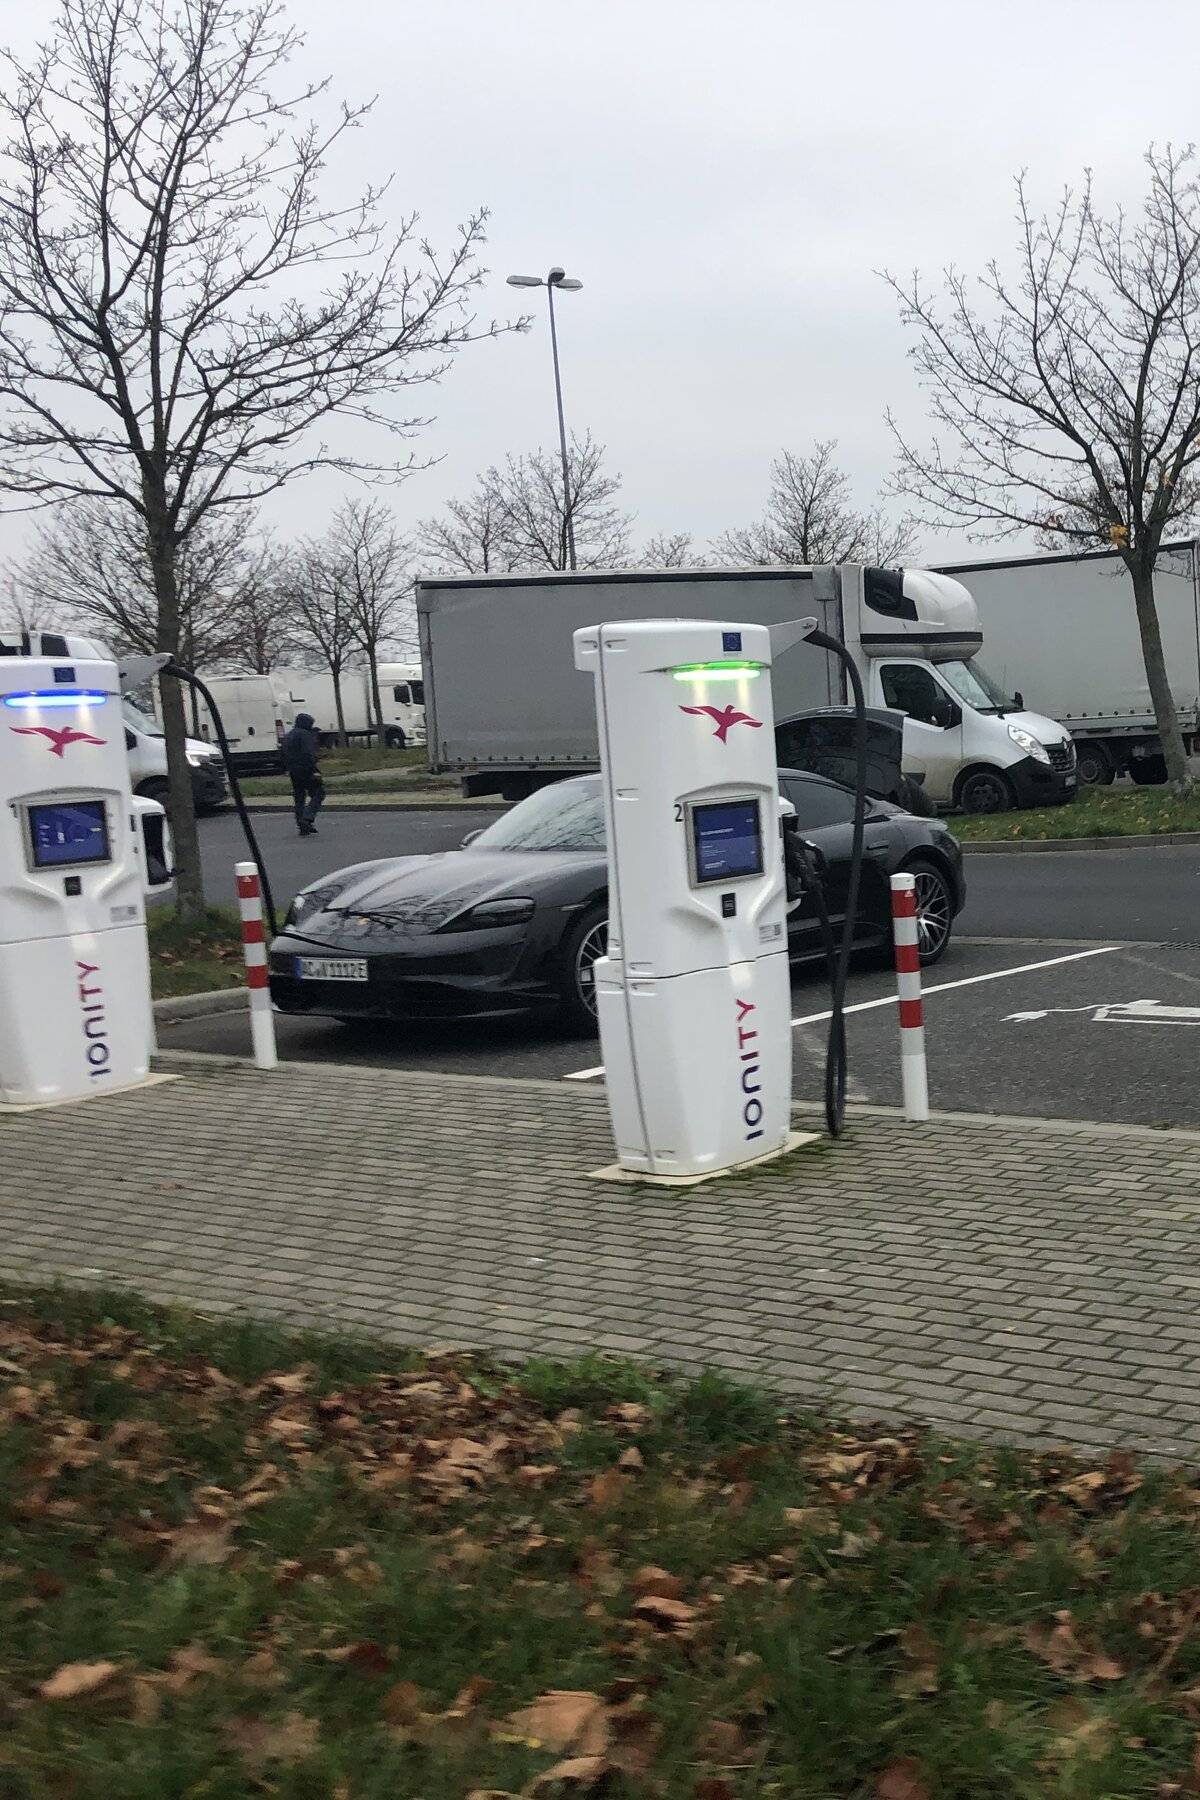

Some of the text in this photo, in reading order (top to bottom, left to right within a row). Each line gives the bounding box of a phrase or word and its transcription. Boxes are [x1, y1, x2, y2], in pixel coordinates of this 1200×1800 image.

[673, 803, 684, 823] 2
[76, 960, 111, 1077] IONITY
[735, 998, 764, 1141] IONITY
